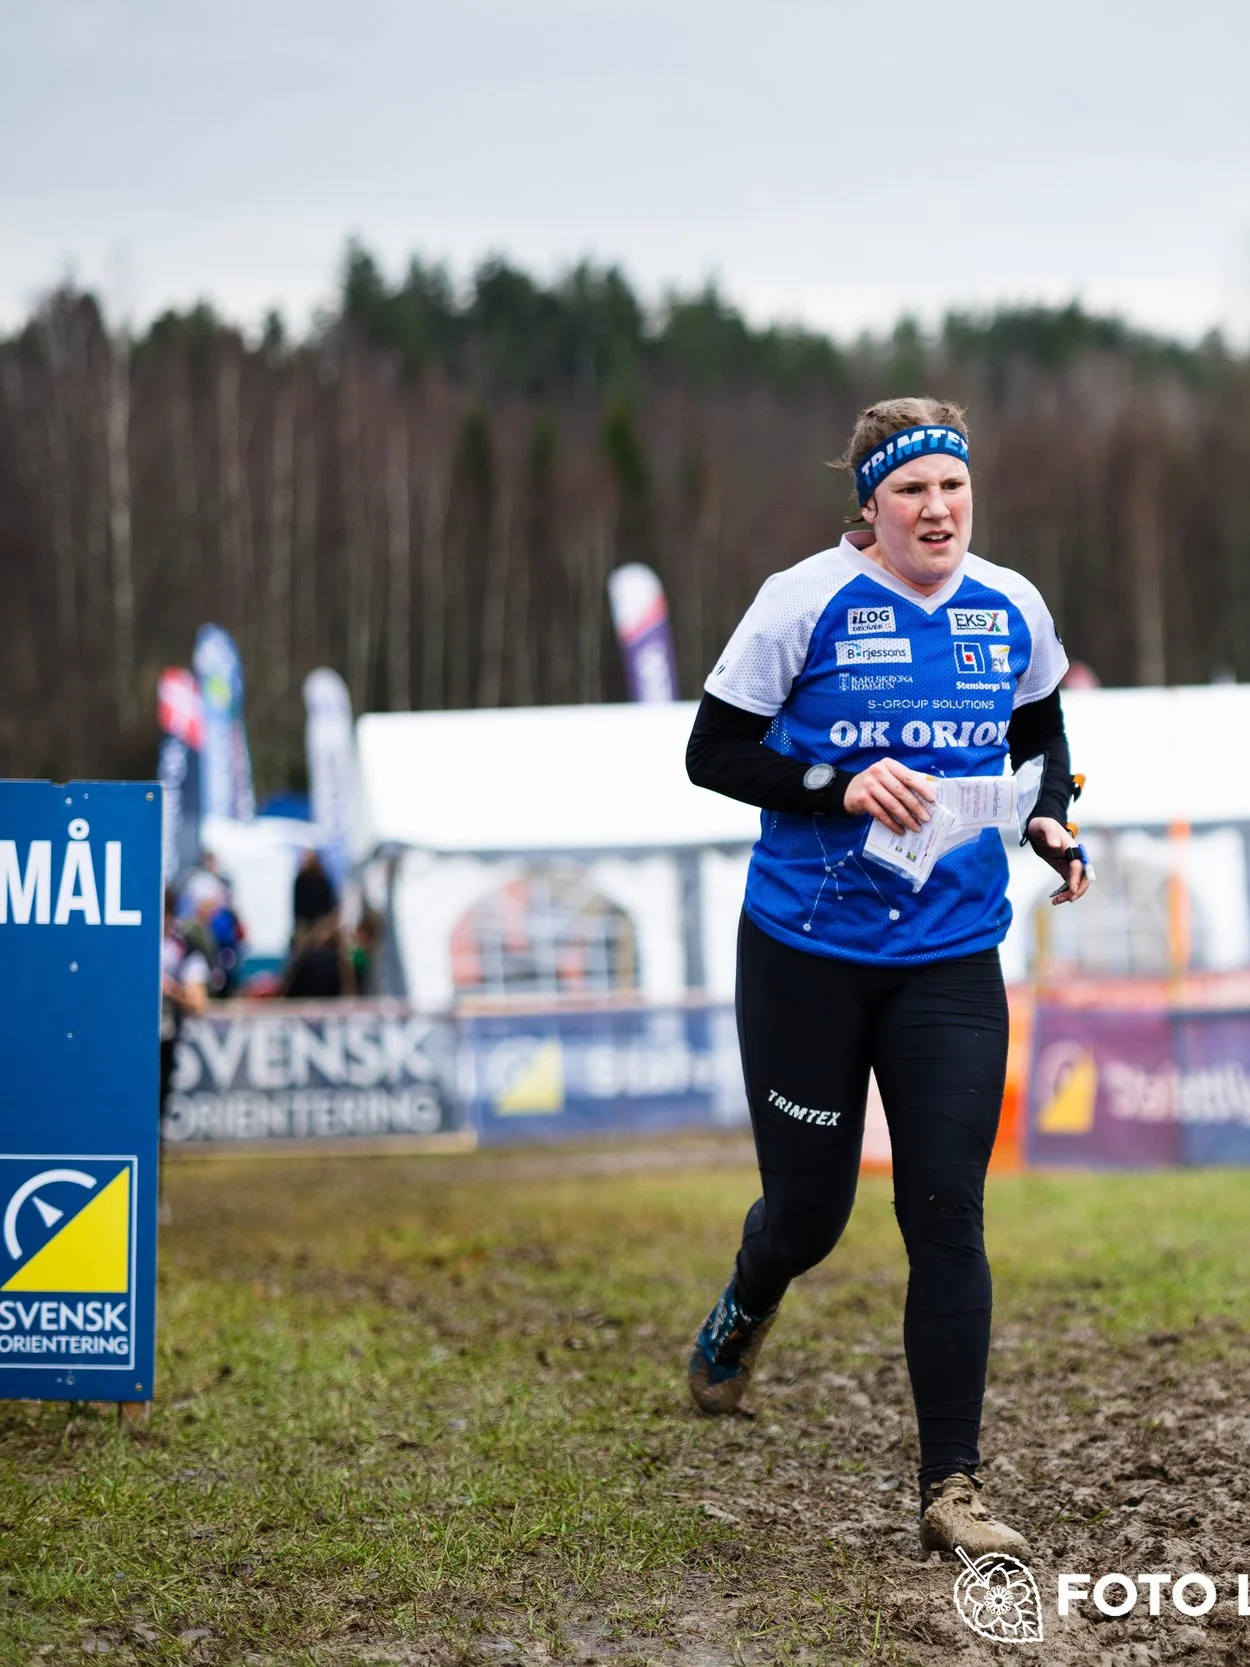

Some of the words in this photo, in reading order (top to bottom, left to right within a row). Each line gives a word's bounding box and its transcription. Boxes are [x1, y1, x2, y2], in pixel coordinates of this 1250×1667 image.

[861, 429, 969, 487] TRIMTEX
[851, 675, 914, 683] KARLSKRONA
[851, 682, 895, 691] KOMMUN
[932, 699, 995, 709] SOLUTIONS
[829, 720, 891, 748] OK
[0, 818, 142, 925] MÅL
[170, 1015, 438, 1092] SVENSK
[162, 1085, 442, 1142] ORIENTERING
[768, 1089, 841, 1126] TRIMTEX
[0, 1300, 128, 1332] SVENSK
[0, 1334, 129, 1355] ORIENTERING
